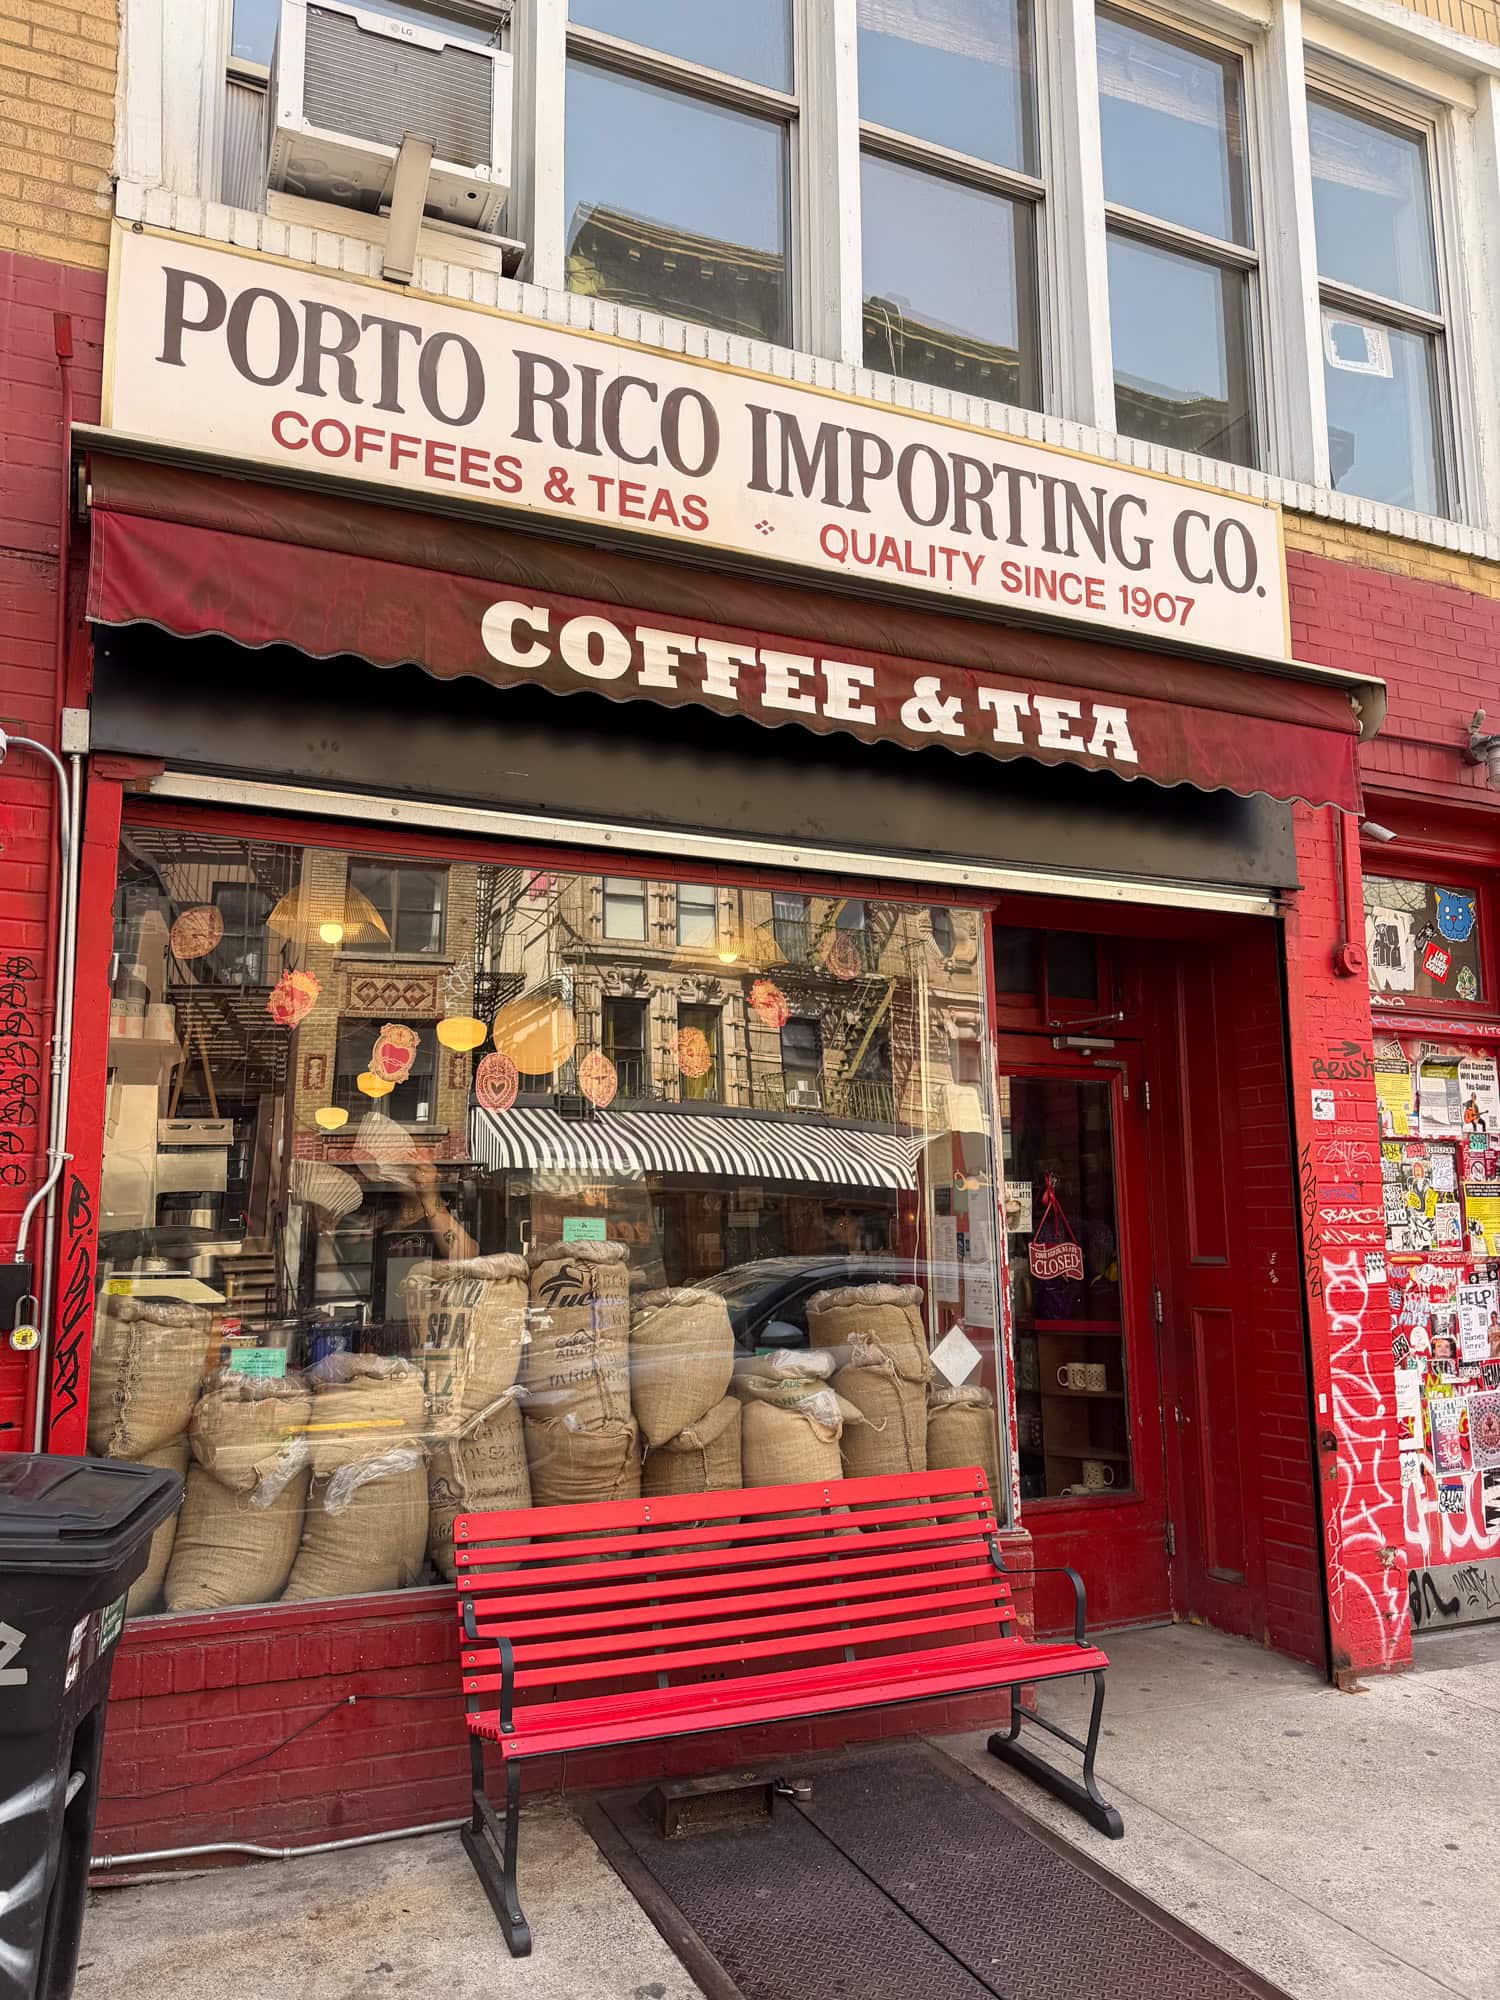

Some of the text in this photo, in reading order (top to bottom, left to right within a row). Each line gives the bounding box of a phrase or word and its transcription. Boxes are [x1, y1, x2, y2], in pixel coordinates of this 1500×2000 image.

[155, 266, 1266, 597] PORTO RICO IMPORTING CO.
[270, 410, 710, 532] COFFEES & TEAS
[819, 523, 1196, 626] QUALITY SINCE 1907
[480, 600, 1140, 764] COFFEE & TEA
[1034, 1253, 1079, 1275] CLOSED
[1459, 1289, 1496, 1306] HELP!
